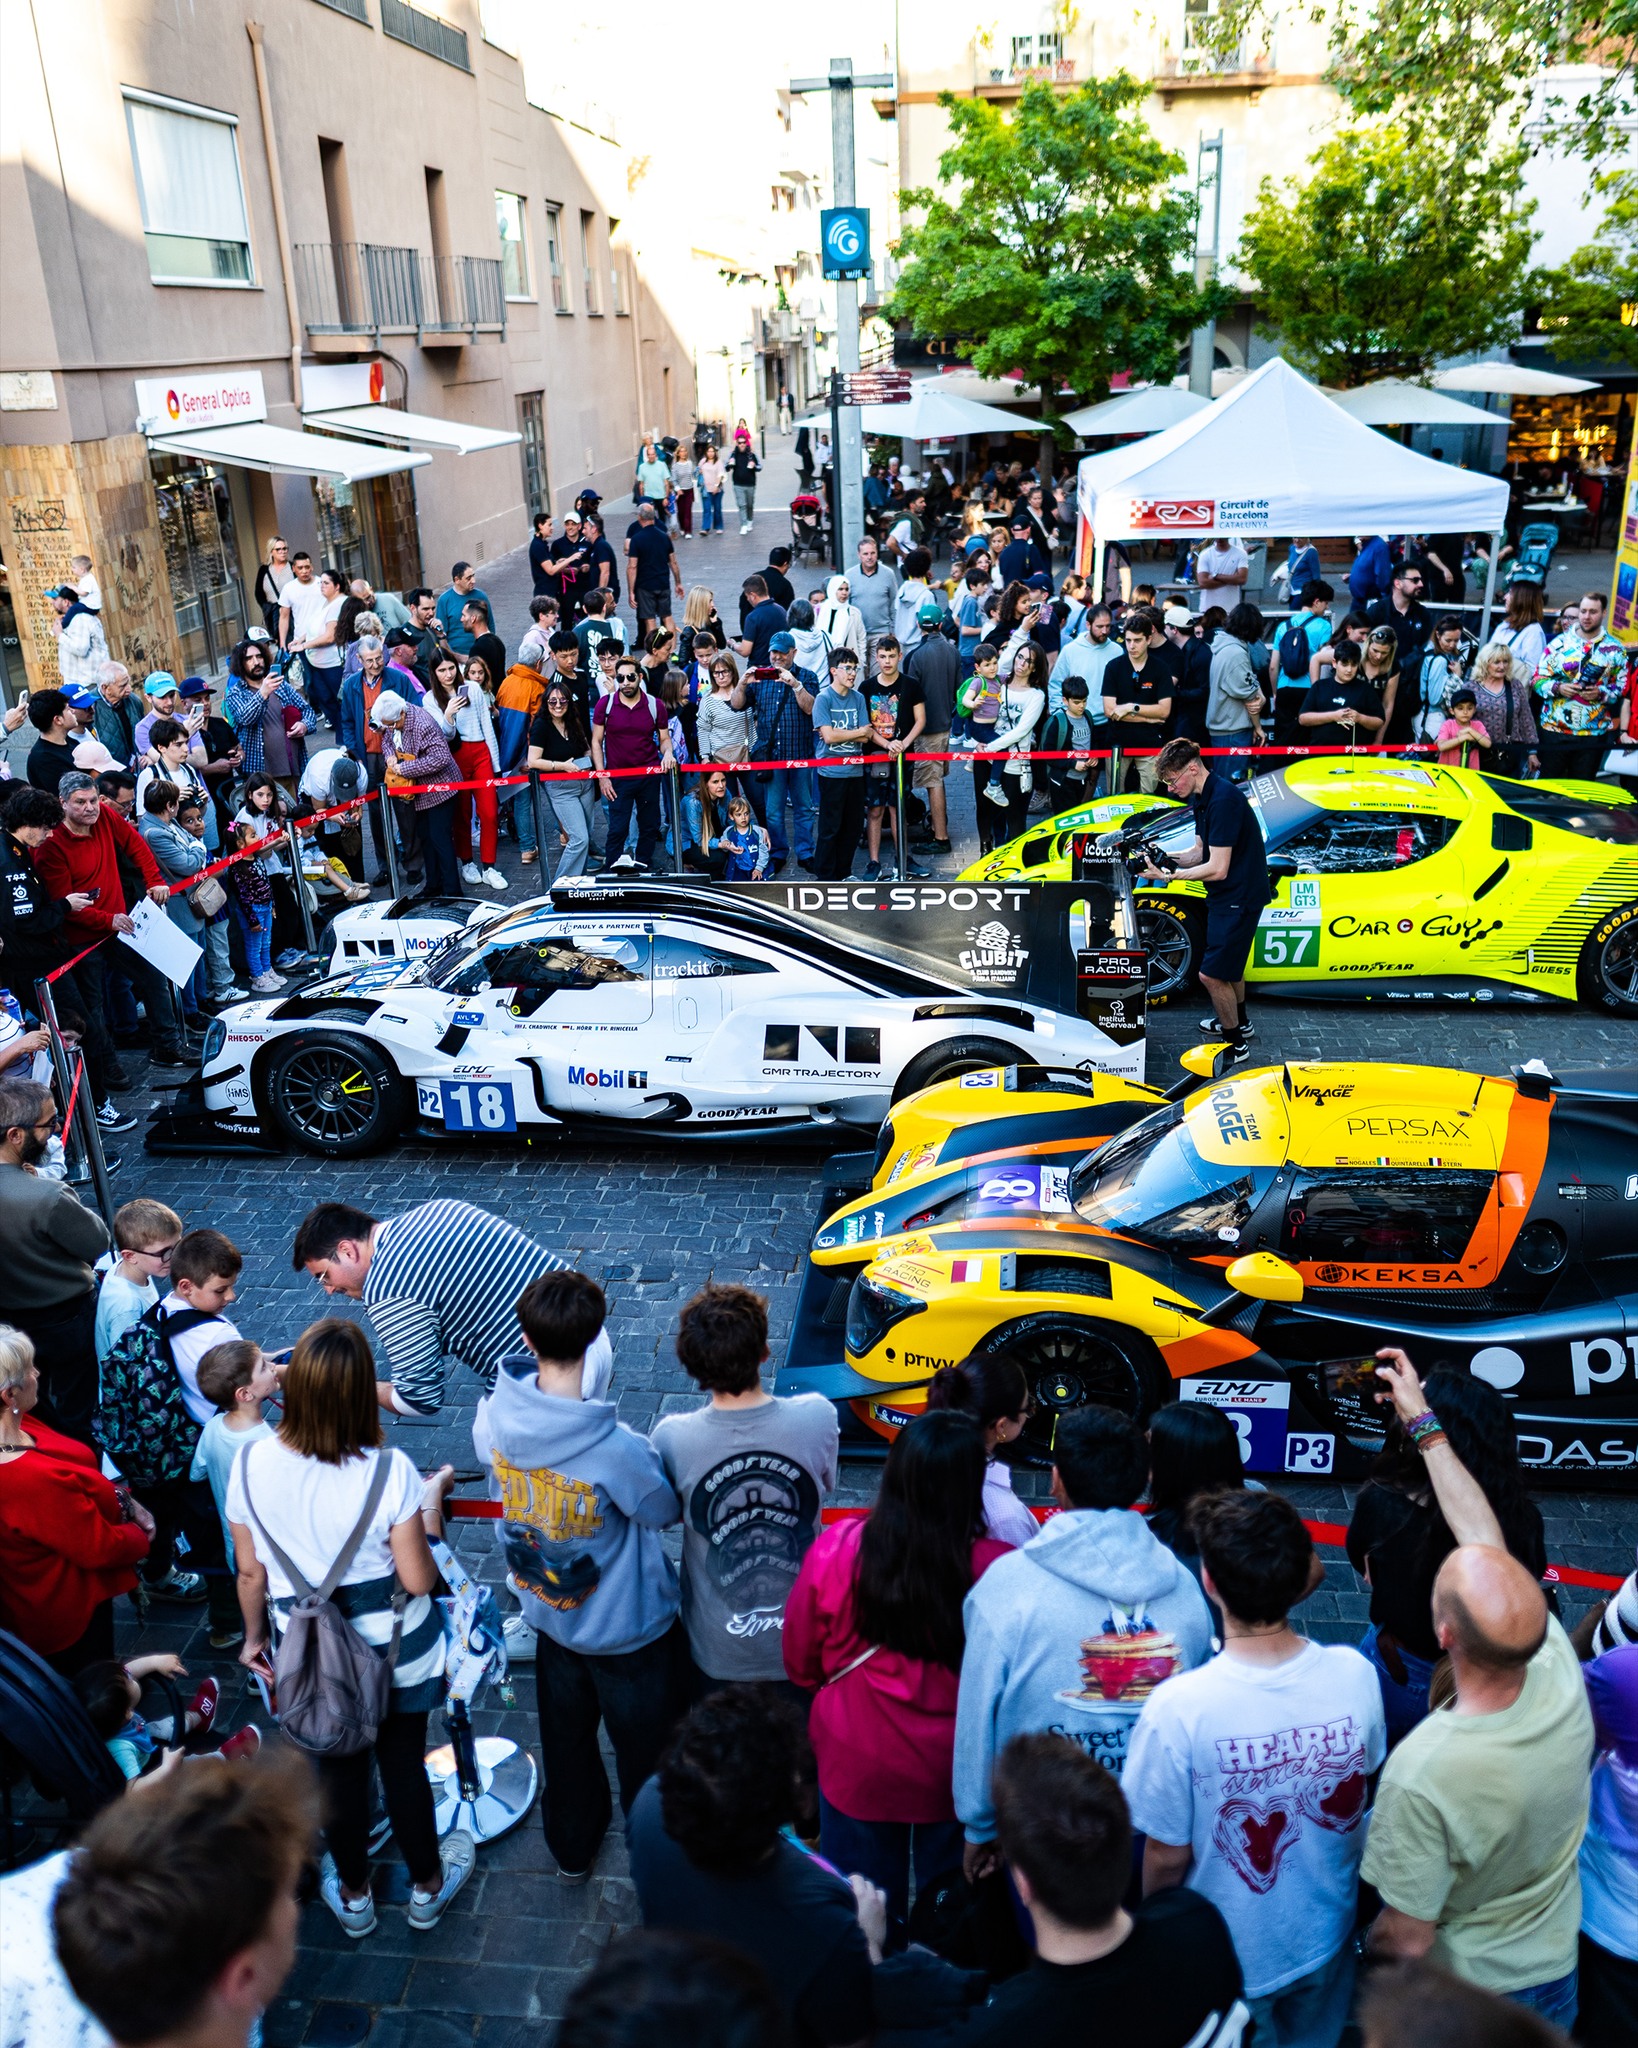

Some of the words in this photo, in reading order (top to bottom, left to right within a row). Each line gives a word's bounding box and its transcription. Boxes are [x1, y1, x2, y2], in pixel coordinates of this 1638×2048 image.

[182, 389, 220, 412] General
[221, 386, 251, 412] Optica
[1220, 500, 1254, 509] Circuit
[1256, 499, 1269, 509] de
[1220, 510, 1269, 520] Barcelona
[1219, 521, 1268, 529] CATALUNYA
[568, 889, 591, 899] Eden
[592, 888, 625, 898] Park
[1296, 883, 1314, 894] LM
[1294, 895, 1316, 906] GT3
[1264, 930, 1313, 964] 57
[654, 960, 711, 977] trackit
[1098, 957, 1130, 966] PRO
[1084, 965, 1142, 974] RACING
[1531, 965, 1572, 975] GUESS
[1098, 1015, 1126, 1023] Institut
[1105, 1021, 1137, 1029] Cerveau
[228, 1034, 265, 1042] RHEOSOL
[568, 1065, 624, 1088] Mobil
[762, 1067, 791, 1076] GMR
[793, 1069, 881, 1079] TRAJECTORY
[965, 1072, 993, 1087] P3
[227, 1087, 249, 1099] HMS
[1294, 1085, 1353, 1098] VIRAGE
[419, 1086, 441, 1114] P2
[449, 1085, 506, 1128] 18
[1244, 1113, 1262, 1140] TEAM
[1346, 1118, 1469, 1140] PERSAX
[898, 1263, 926, 1276] PRO
[1352, 1268, 1464, 1283] KEKSA
[883, 1266, 931, 1289] RACING
[1288, 1437, 1331, 1469] P3
[529, 1470, 603, 1530] BULL
[504, 1509, 594, 1543] ACING
[720, 1554, 800, 1588] GOODYEA
[1048, 1725, 1127, 1750] Sweet
[1215, 1716, 1354, 1774] HEART
